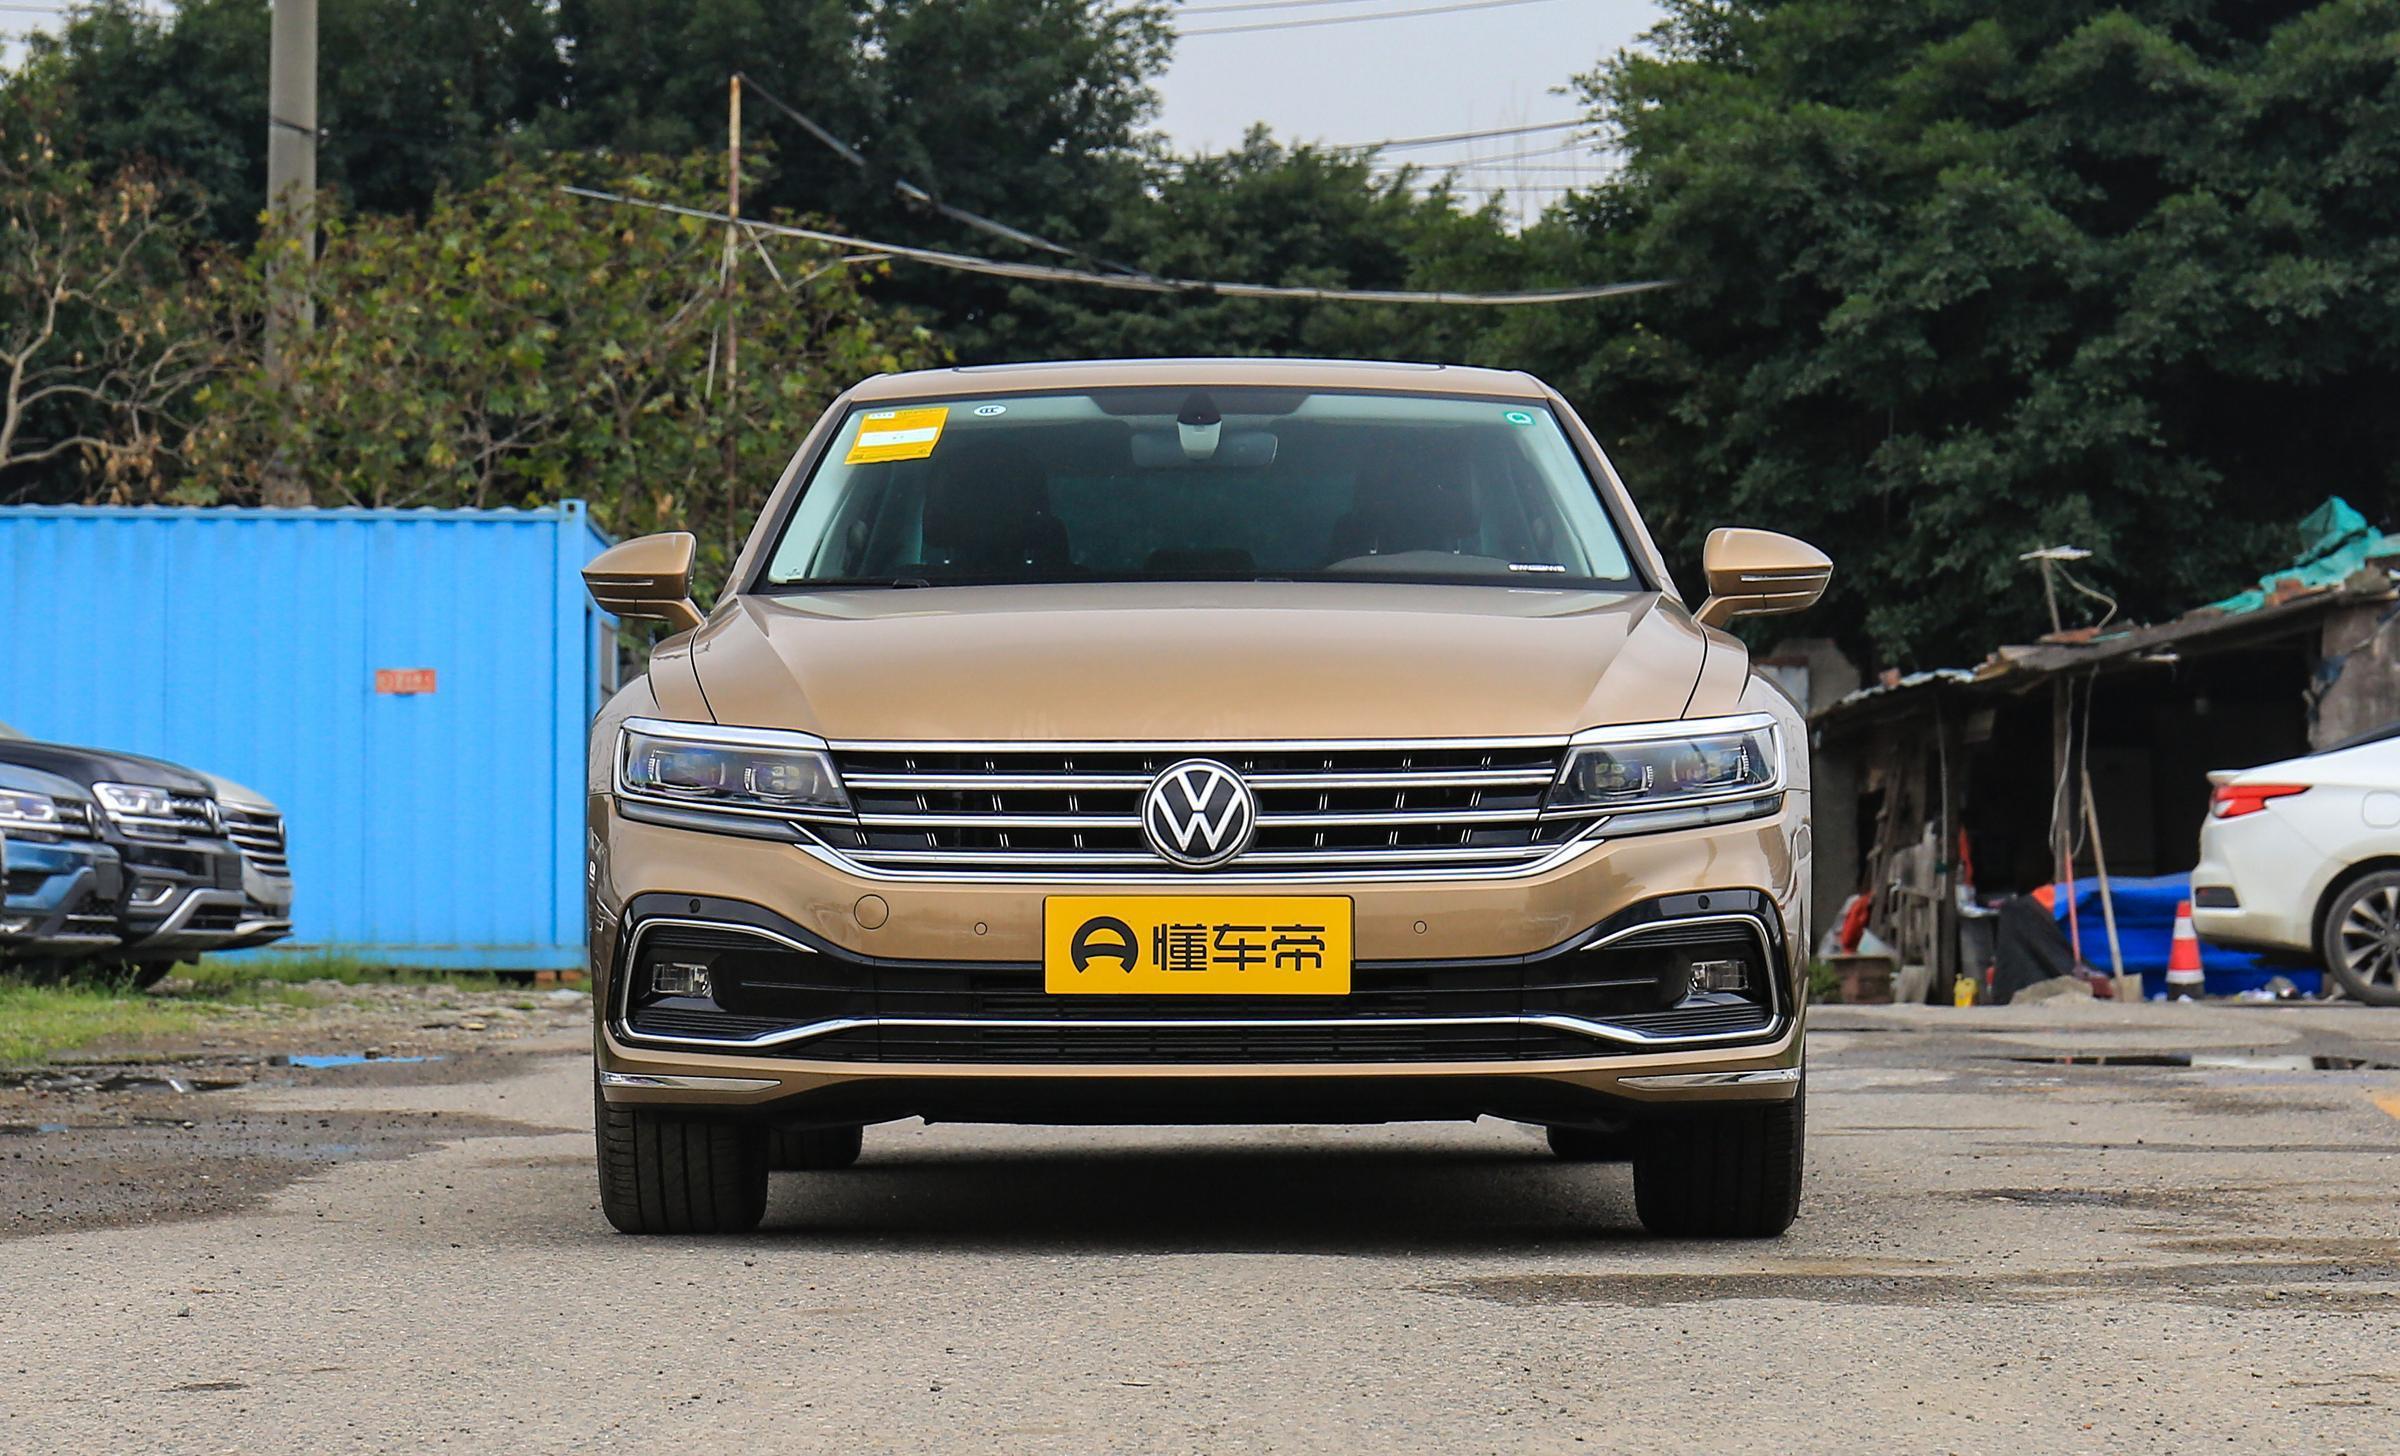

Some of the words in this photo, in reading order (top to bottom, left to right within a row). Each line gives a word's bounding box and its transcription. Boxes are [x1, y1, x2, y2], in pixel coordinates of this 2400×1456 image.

[1150, 767, 1247, 857] VW
[1153, 924, 1325, 971] 懂车帝
